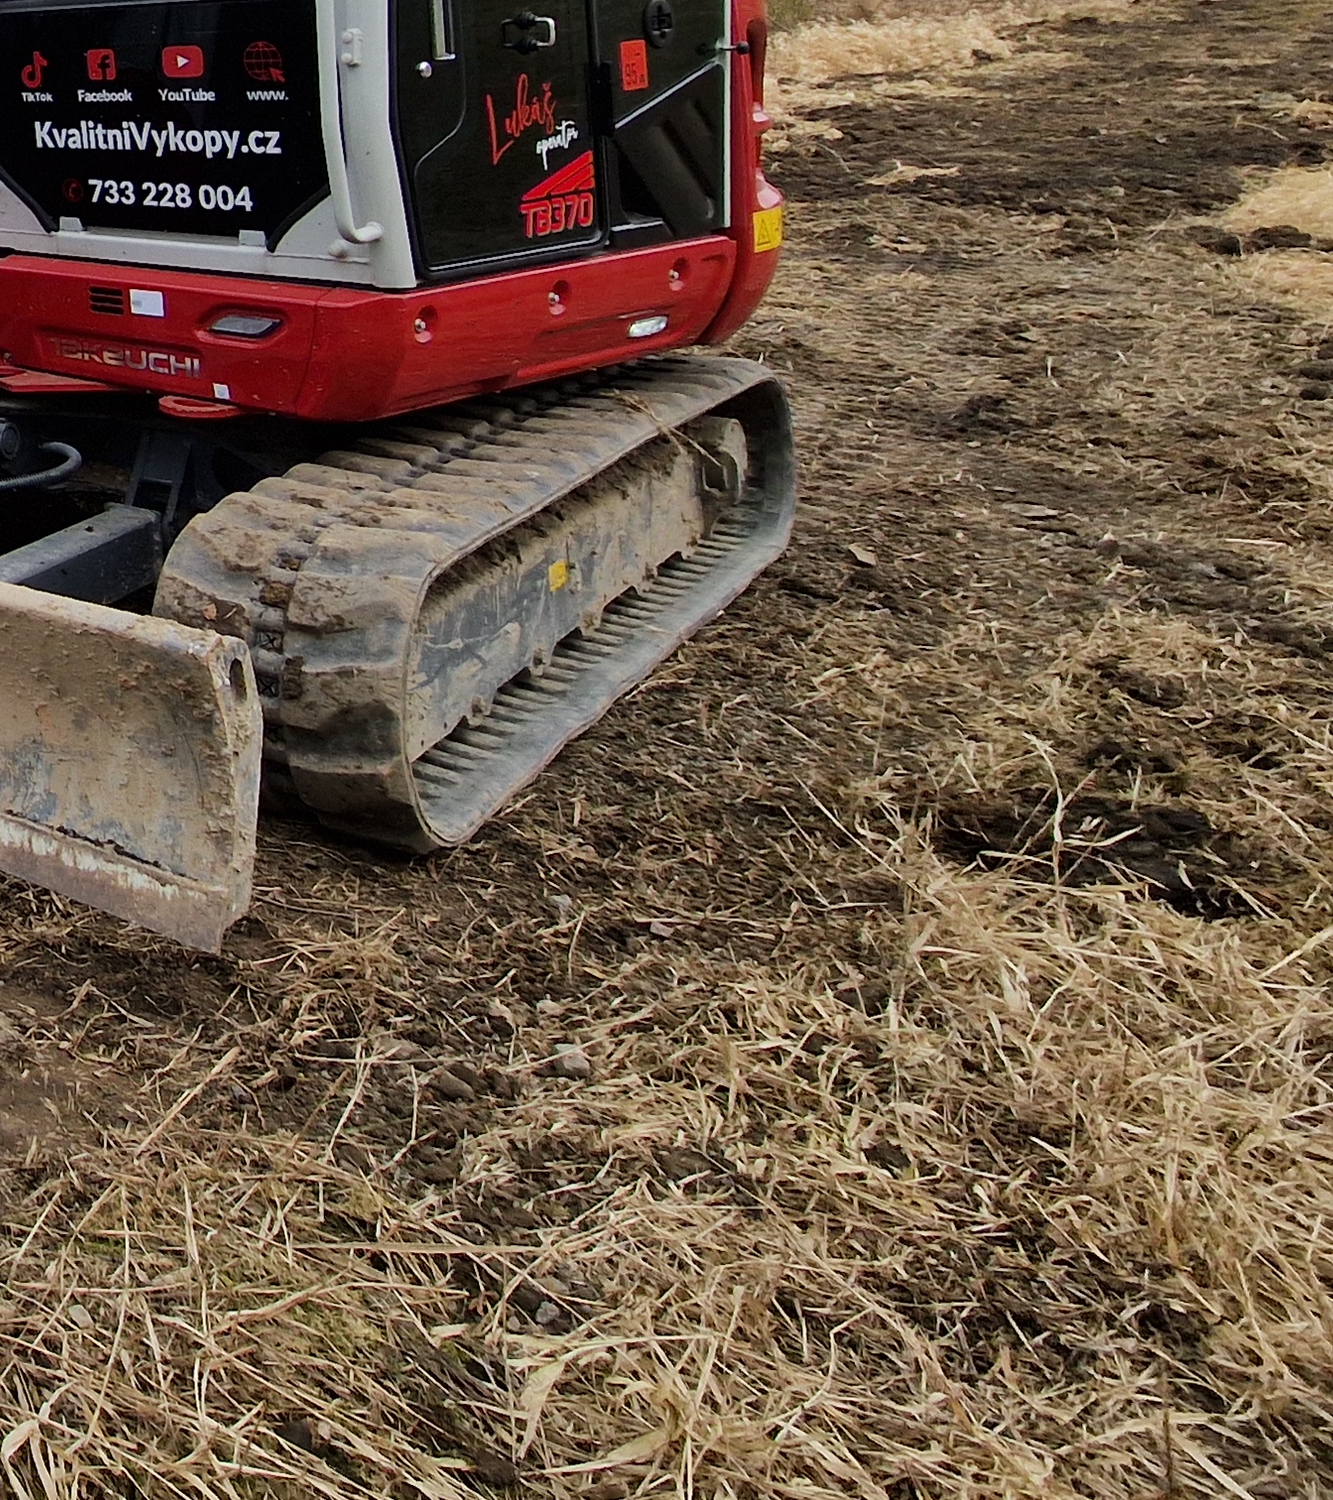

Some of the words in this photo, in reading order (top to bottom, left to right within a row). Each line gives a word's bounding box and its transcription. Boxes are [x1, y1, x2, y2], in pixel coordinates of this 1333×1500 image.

[21, 92, 53, 102] TikTok
[77, 89, 133, 102] Facebook
[158, 88, 216, 102] YouTube
[246, 90, 289, 101] www.
[486, 73, 557, 165] Lukáš
[34, 120, 282, 159] KvalitniVykopy.cz
[88, 179, 135, 205] 733
[142, 182, 192, 209] 228
[198, 184, 253, 212] 004
[519, 192, 594, 238] TB370
